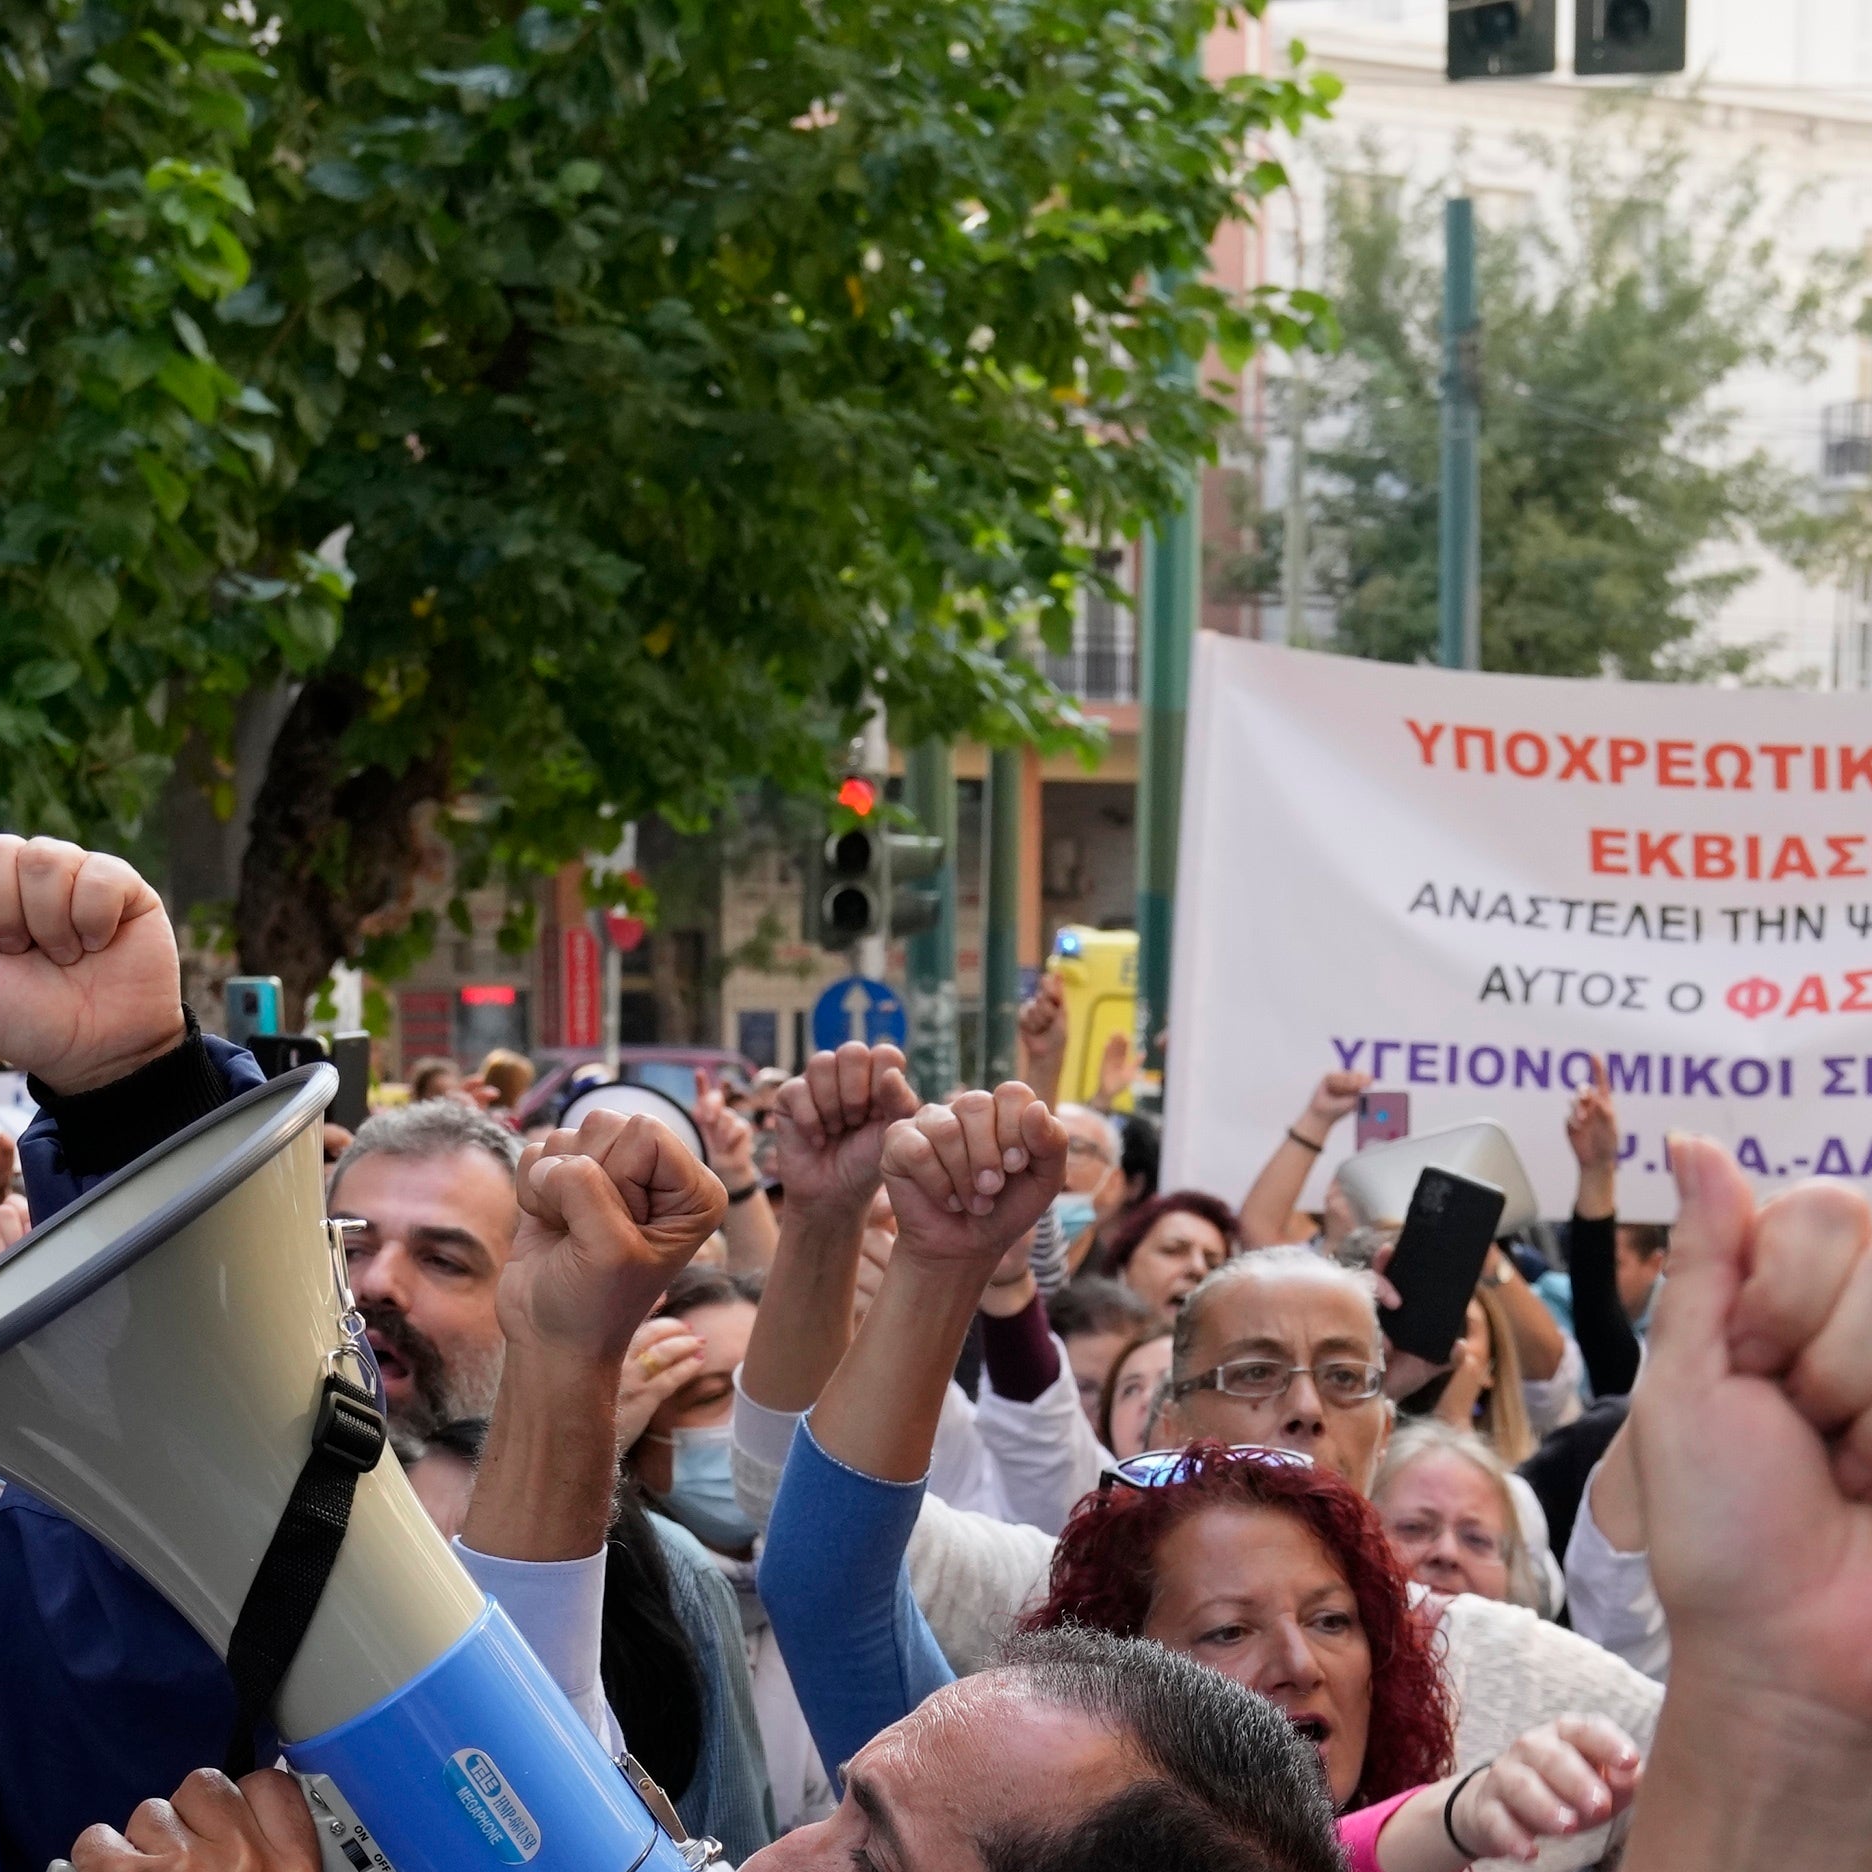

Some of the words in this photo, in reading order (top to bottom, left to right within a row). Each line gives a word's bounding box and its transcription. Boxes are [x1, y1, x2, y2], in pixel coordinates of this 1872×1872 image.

[1409, 880, 1704, 943] ΑΝΑΣΤΕΛΕΙ
[1719, 903, 1827, 944] ΤΗΝ
[1477, 964, 1649, 1012] ΑΥΤΟΣ
[1666, 980, 1705, 1014] Ο
[1331, 1037, 1793, 1098] ΥΓΕΙΟΝΟΜΙΚΟΙ
[354, 1824, 370, 1842] ON
[456, 1786, 504, 1846] MEGAPHONE
[373, 1853, 392, 1872] OFF
